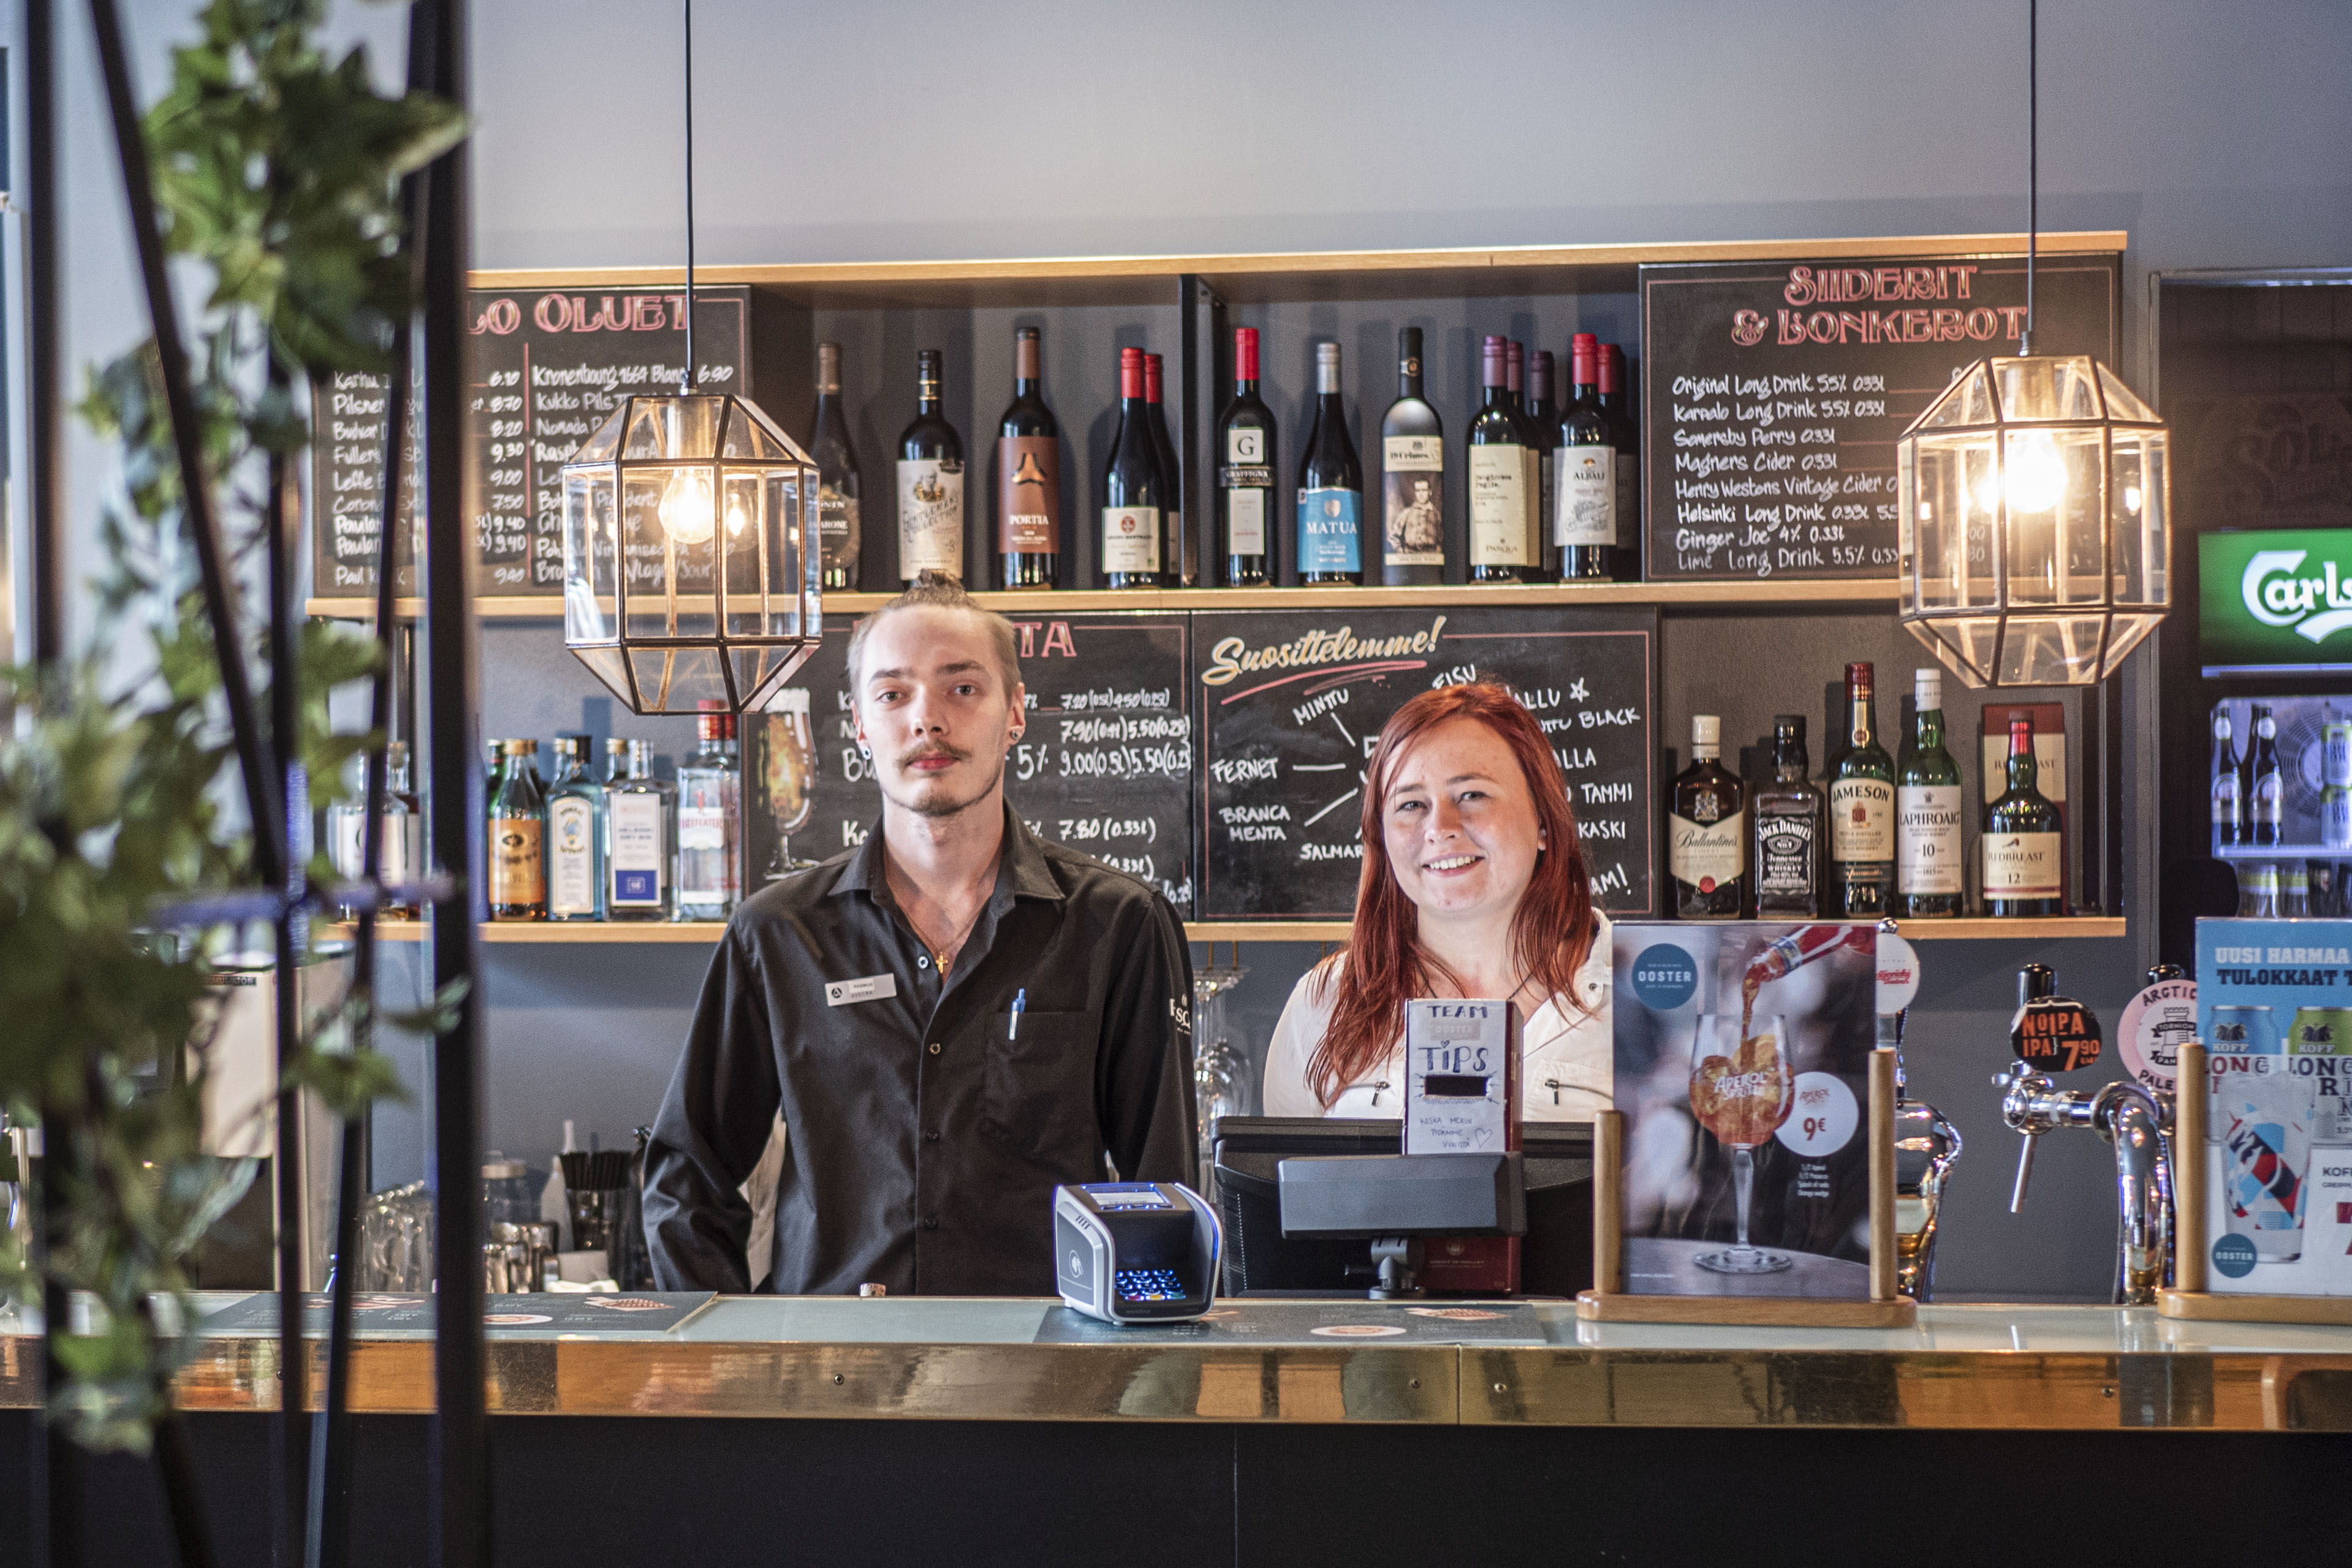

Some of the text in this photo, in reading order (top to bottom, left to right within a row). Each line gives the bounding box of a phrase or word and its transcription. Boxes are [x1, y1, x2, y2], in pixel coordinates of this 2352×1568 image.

[1784, 265, 1978, 305] SIIDERIT
[534, 294, 697, 332] OLUET
[1777, 306, 2027, 345] LONKEROT
[335, 370, 379, 390] Karhu
[650, 365, 684, 384] Blan
[697, 365, 733, 384] 6.90
[1672, 374, 1729, 402] Original
[1735, 375, 1771, 400] Long
[1773, 373, 1814, 393] Drink
[333, 393, 385, 415] Pilsner
[584, 392, 613, 411] Pils
[1673, 403, 1729, 422] Karpalo
[1736, 404, 1773, 426] Long
[1777, 400, 1817, 419] Drink
[1237, 436, 1255, 456] G
[1673, 427, 1747, 447] Somersby
[1752, 425, 1796, 446] Perry
[491, 442, 524, 463] 9.30
[1675, 453, 1747, 478] Magners
[1754, 451, 1796, 472] Cider
[333, 470, 373, 491] Leffe
[490, 469, 523, 487] 9.00
[1675, 473, 1881, 502] Henry Westons Vintage Cider
[335, 514, 381, 536] Paulan
[1010, 515, 1049, 525] PORTIA
[1677, 502, 1736, 524] Helsinki
[1745, 504, 1780, 532] Long
[1785, 504, 1826, 523] Drink
[1307, 521, 1357, 534] MATUA
[336, 534, 381, 559] Paulan
[1675, 528, 1735, 554] Ginger
[1739, 525, 1770, 547] Joe
[1779, 525, 1800, 543] 4%
[1679, 553, 1713, 570] Lime
[1729, 551, 1772, 577] Long
[1778, 547, 1824, 569] Drink
[1832, 544, 1864, 566] 5.5%
[1201, 615, 1446, 685] Suosittelemme!
[1432, 664, 1476, 690] FISU
[1293, 688, 1349, 725] MINTTU
[1579, 707, 1641, 728] BLACK
[1210, 757, 1278, 783] FERNET
[1580, 782, 1633, 804] TAMMI
[1832, 786, 1889, 803] JAMESON
[1218, 804, 1291, 824] BRANCA
[1229, 825, 1287, 842] MENTA
[1578, 820, 1626, 839] KASKI
[1758, 823, 1779, 841] JACK
[1299, 843, 1363, 861] SALMAR
[1922, 843, 1935, 858] 10
[2008, 874, 2020, 884] 12
[2215, 947, 2350, 964] UUSI HARMAA
[1638, 971, 1691, 982] OOSTER
[2217, 969, 2339, 986] TULOKKAAT
[2142, 985, 2197, 1007] ARCTIC
[1427, 1006, 1488, 1018] TEAM
[2022, 1012, 2086, 1037] NOIPA
[2023, 1038, 2052, 1057] IPA
[2212, 1043, 2250, 1053] KOFF
[2298, 1044, 2336, 1053] KOFF
[2210, 1056, 2269, 1075] ONG
[1714, 1073, 1769, 1093] APEROL
[2138, 1069, 2174, 1091] PALE
[2215, 1251, 2253, 1261] OOSTER
